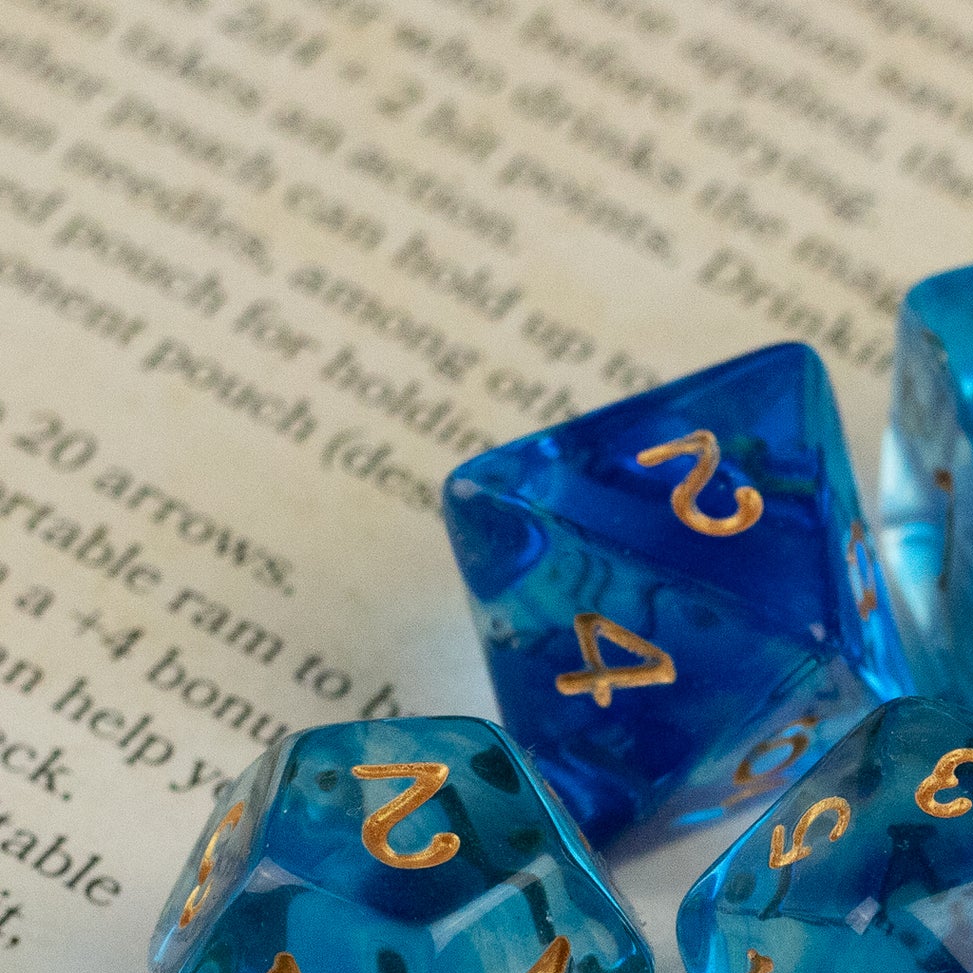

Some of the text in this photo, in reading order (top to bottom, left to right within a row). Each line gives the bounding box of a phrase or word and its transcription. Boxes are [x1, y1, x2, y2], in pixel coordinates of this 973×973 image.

[138, 335, 322, 445] pouch
[10, 408, 298, 598] 20 arrows.
[165, 583, 287, 668] ram
[290, 650, 353, 703] to
[555, 612, 677, 707] 4
[52, 675, 178, 767] help
[352, 762, 461, 869] 2
